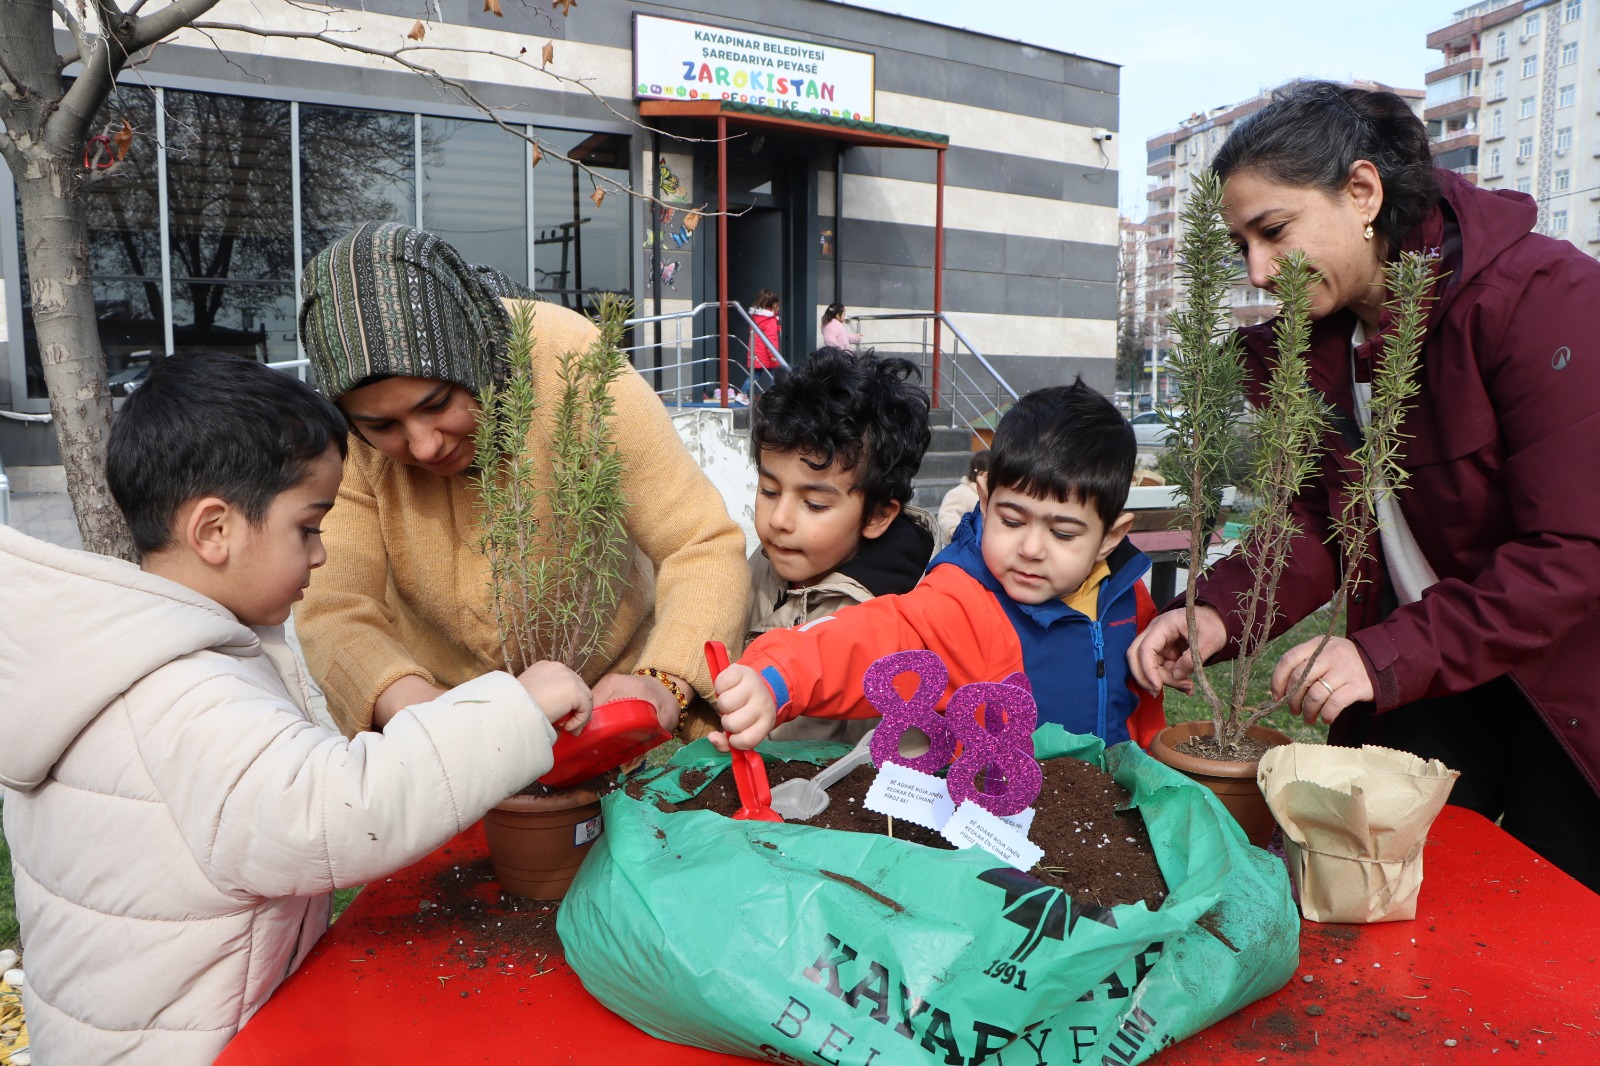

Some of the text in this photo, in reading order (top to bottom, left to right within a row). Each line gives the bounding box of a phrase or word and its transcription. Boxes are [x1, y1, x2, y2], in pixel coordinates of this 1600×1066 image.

[694, 30, 825, 61] KAYAPINAR BELEDİYESİ
[702, 47, 818, 74] ŞAREDARIYA PEYASÊ
[682, 61, 835, 102] ZAROKISTAN
[982, 959, 1028, 992] 1991
